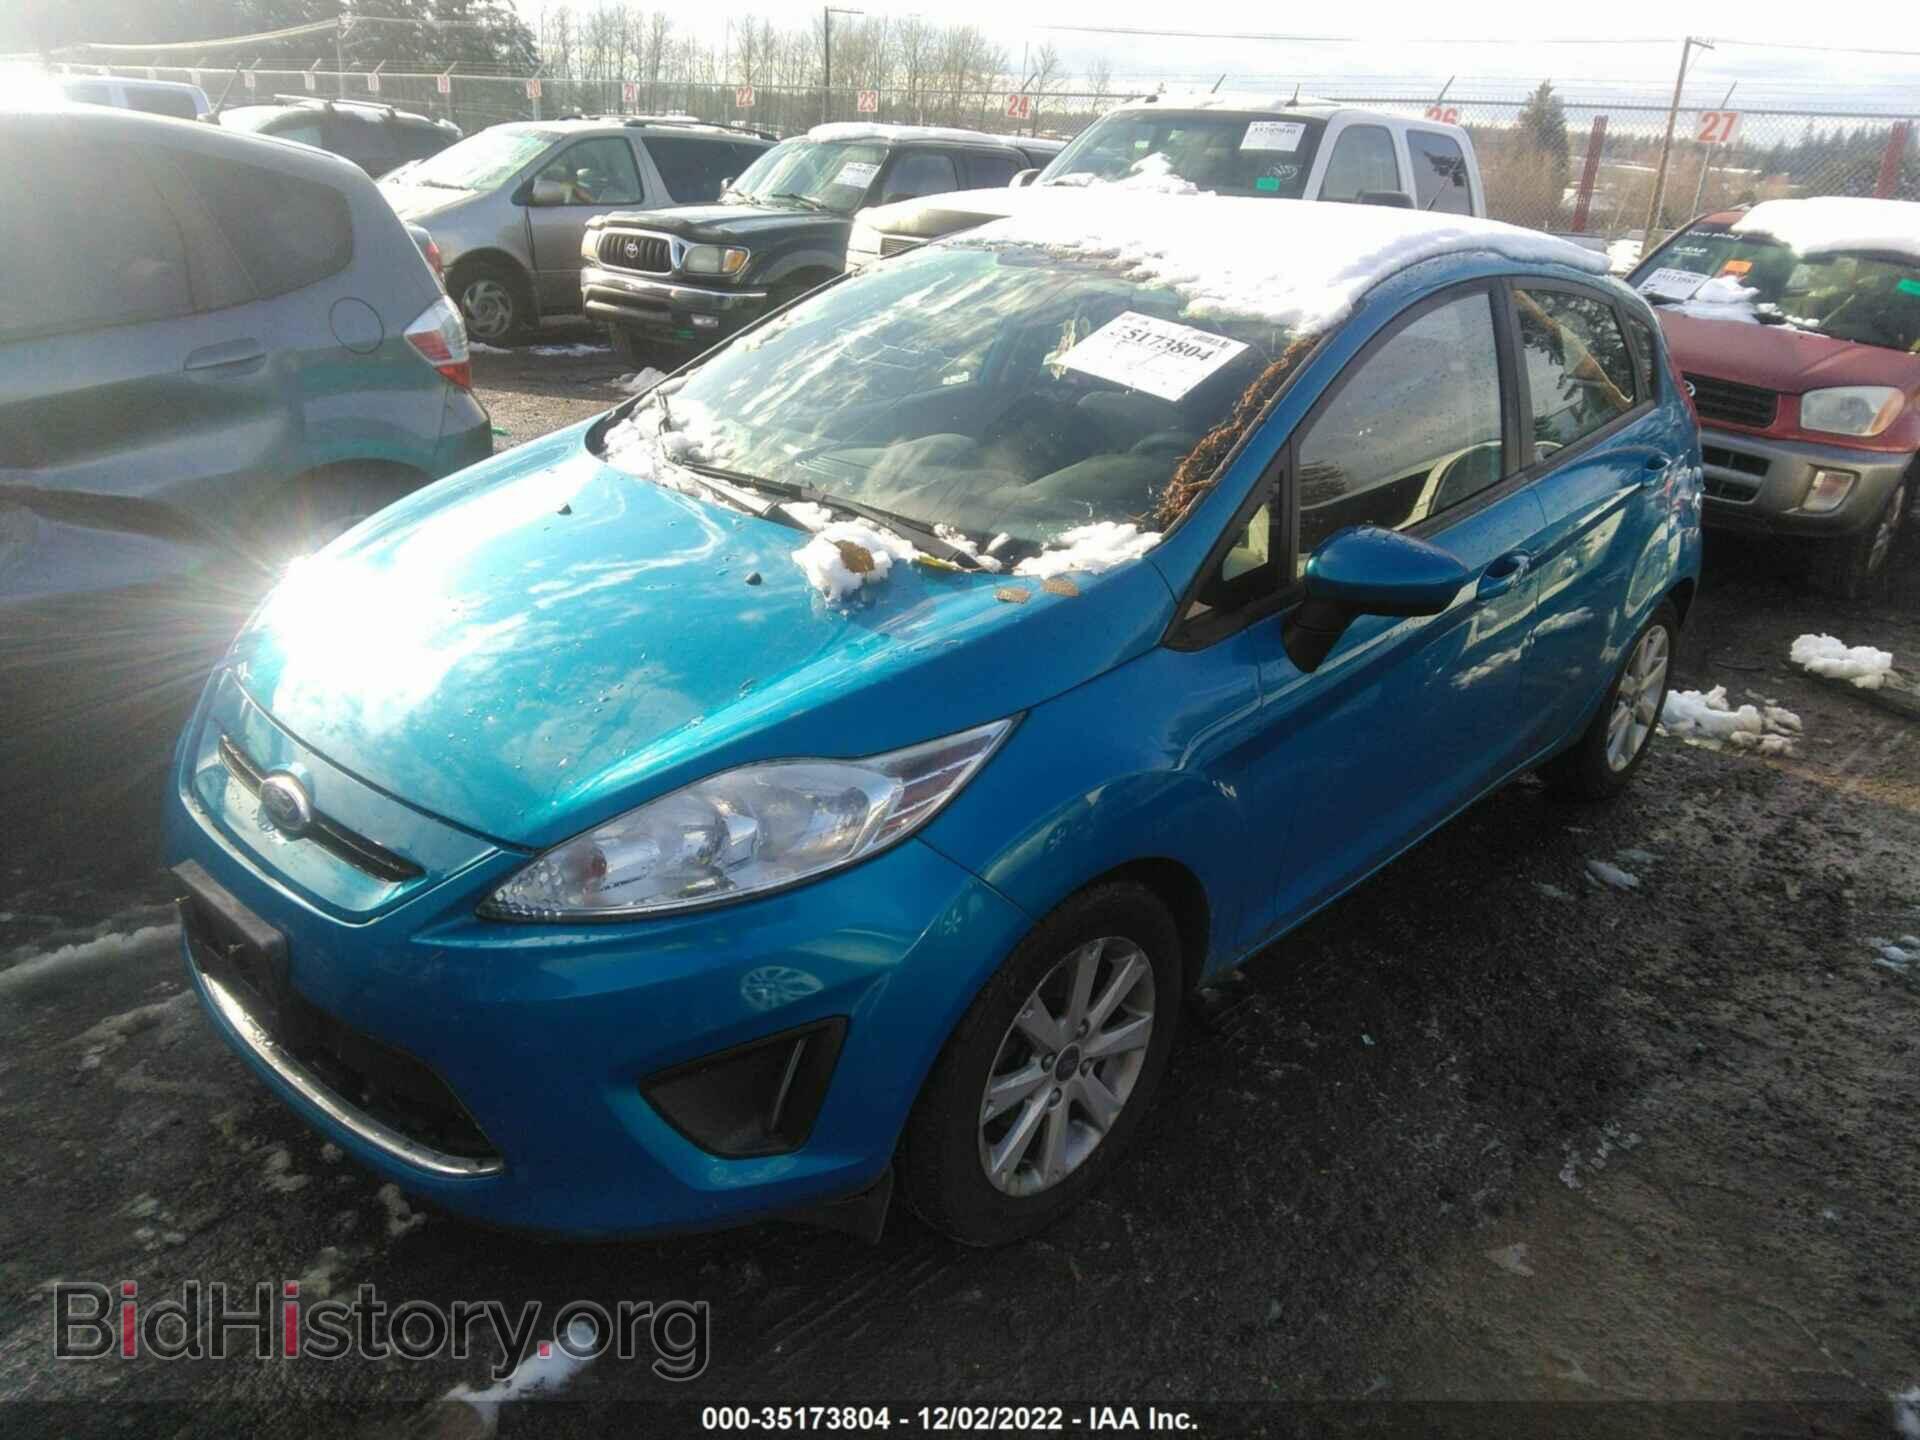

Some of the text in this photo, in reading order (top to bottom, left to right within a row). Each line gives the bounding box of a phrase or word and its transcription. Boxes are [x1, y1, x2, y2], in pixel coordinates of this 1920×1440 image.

[622, 83, 637, 101] 21
[737, 87, 753, 106] 22
[859, 91, 877, 111] 23
[1008, 95, 1029, 118] 24
[1698, 111, 1736, 142] 27
